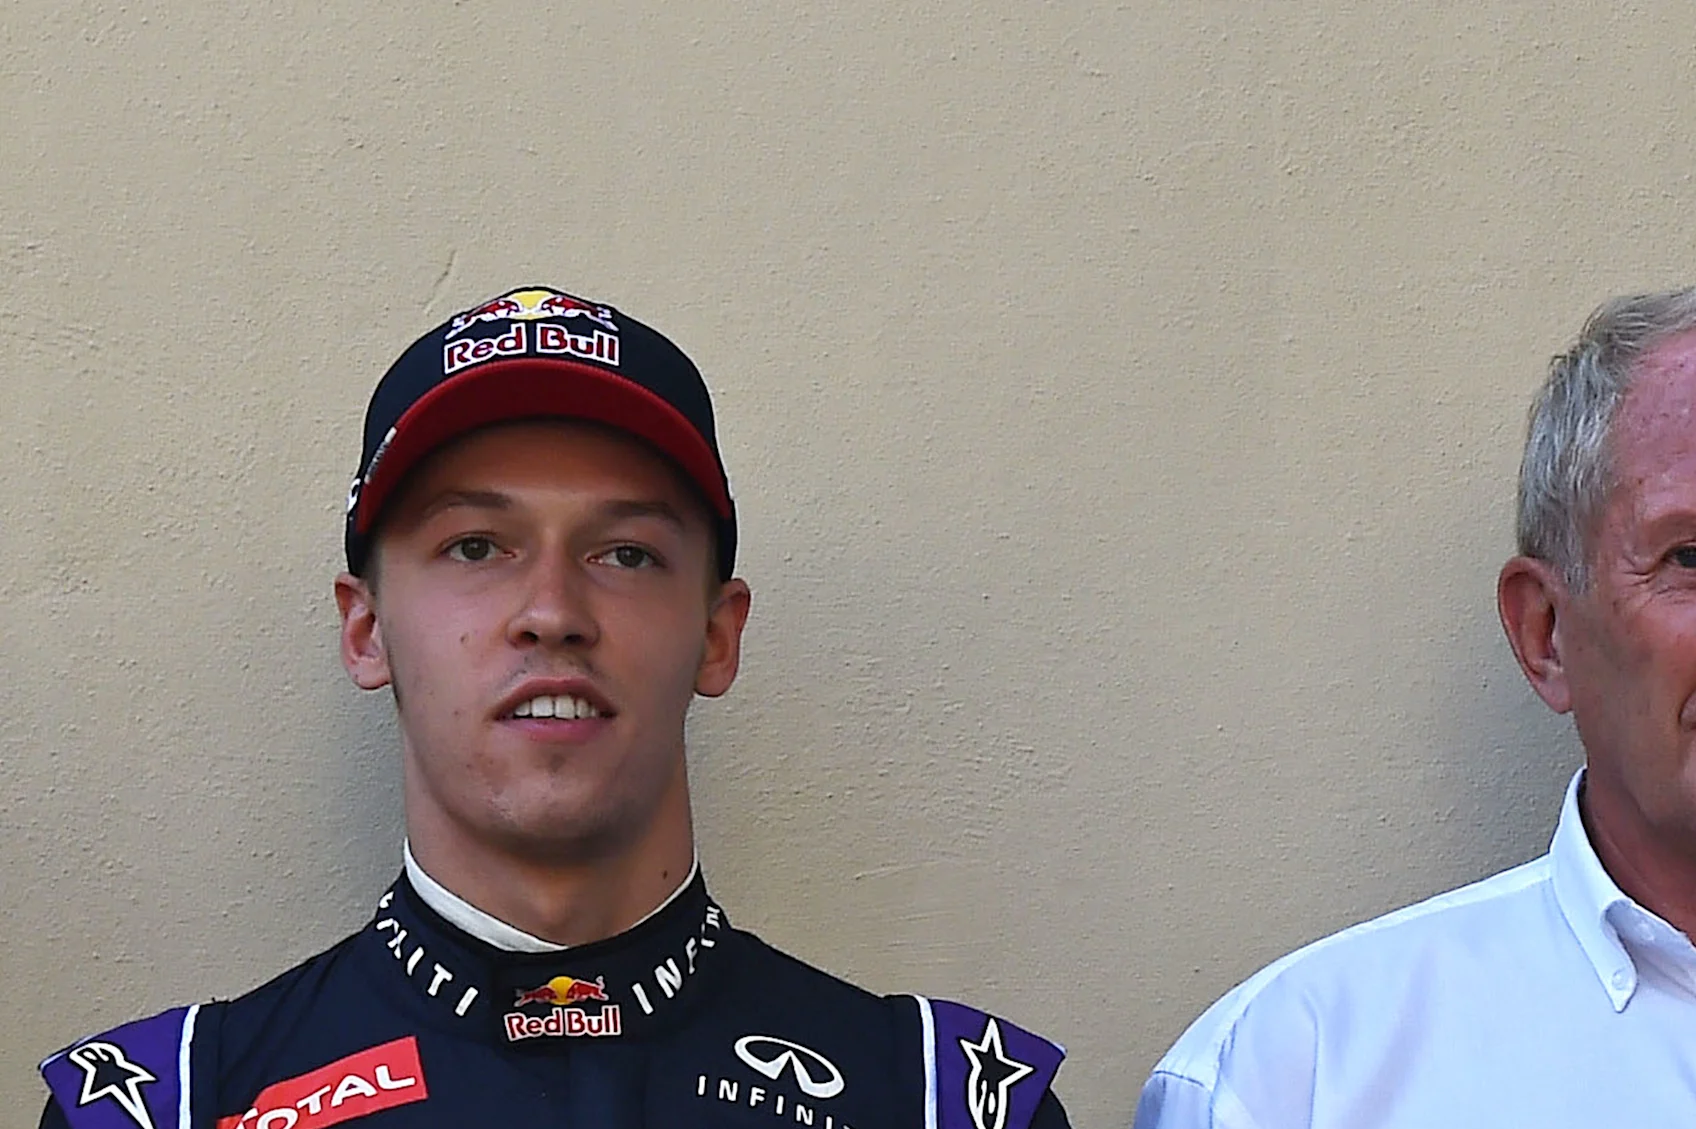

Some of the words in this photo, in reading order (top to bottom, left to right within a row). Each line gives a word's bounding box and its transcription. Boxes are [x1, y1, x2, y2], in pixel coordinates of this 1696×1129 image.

[444, 323, 526, 374] Red
[536, 324, 620, 367] Bull
[504, 1009, 561, 1041] Red
[565, 1005, 621, 1036] Bull
